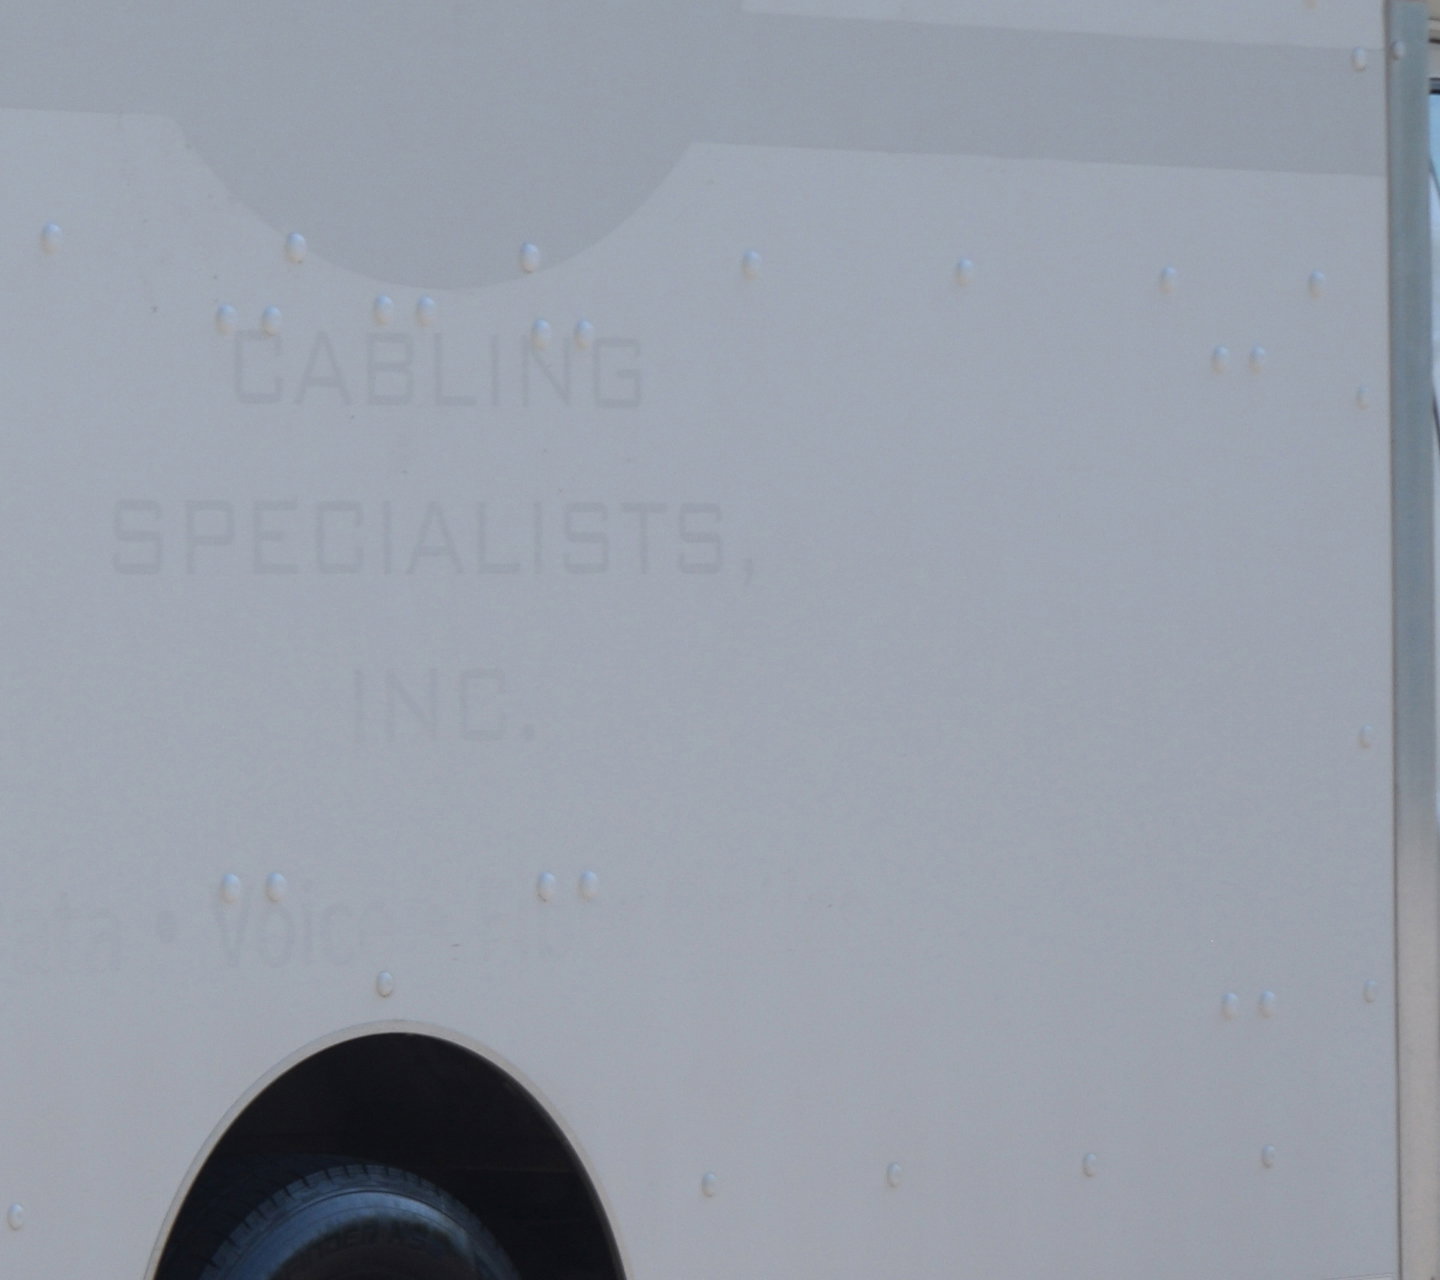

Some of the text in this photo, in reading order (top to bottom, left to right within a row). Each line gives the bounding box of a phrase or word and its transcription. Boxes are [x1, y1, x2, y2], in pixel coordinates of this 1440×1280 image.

[232, 331, 646, 410] CABLING
[111, 498, 758, 586] SPECIALISTS,
[352, 667, 537, 744] INC.
